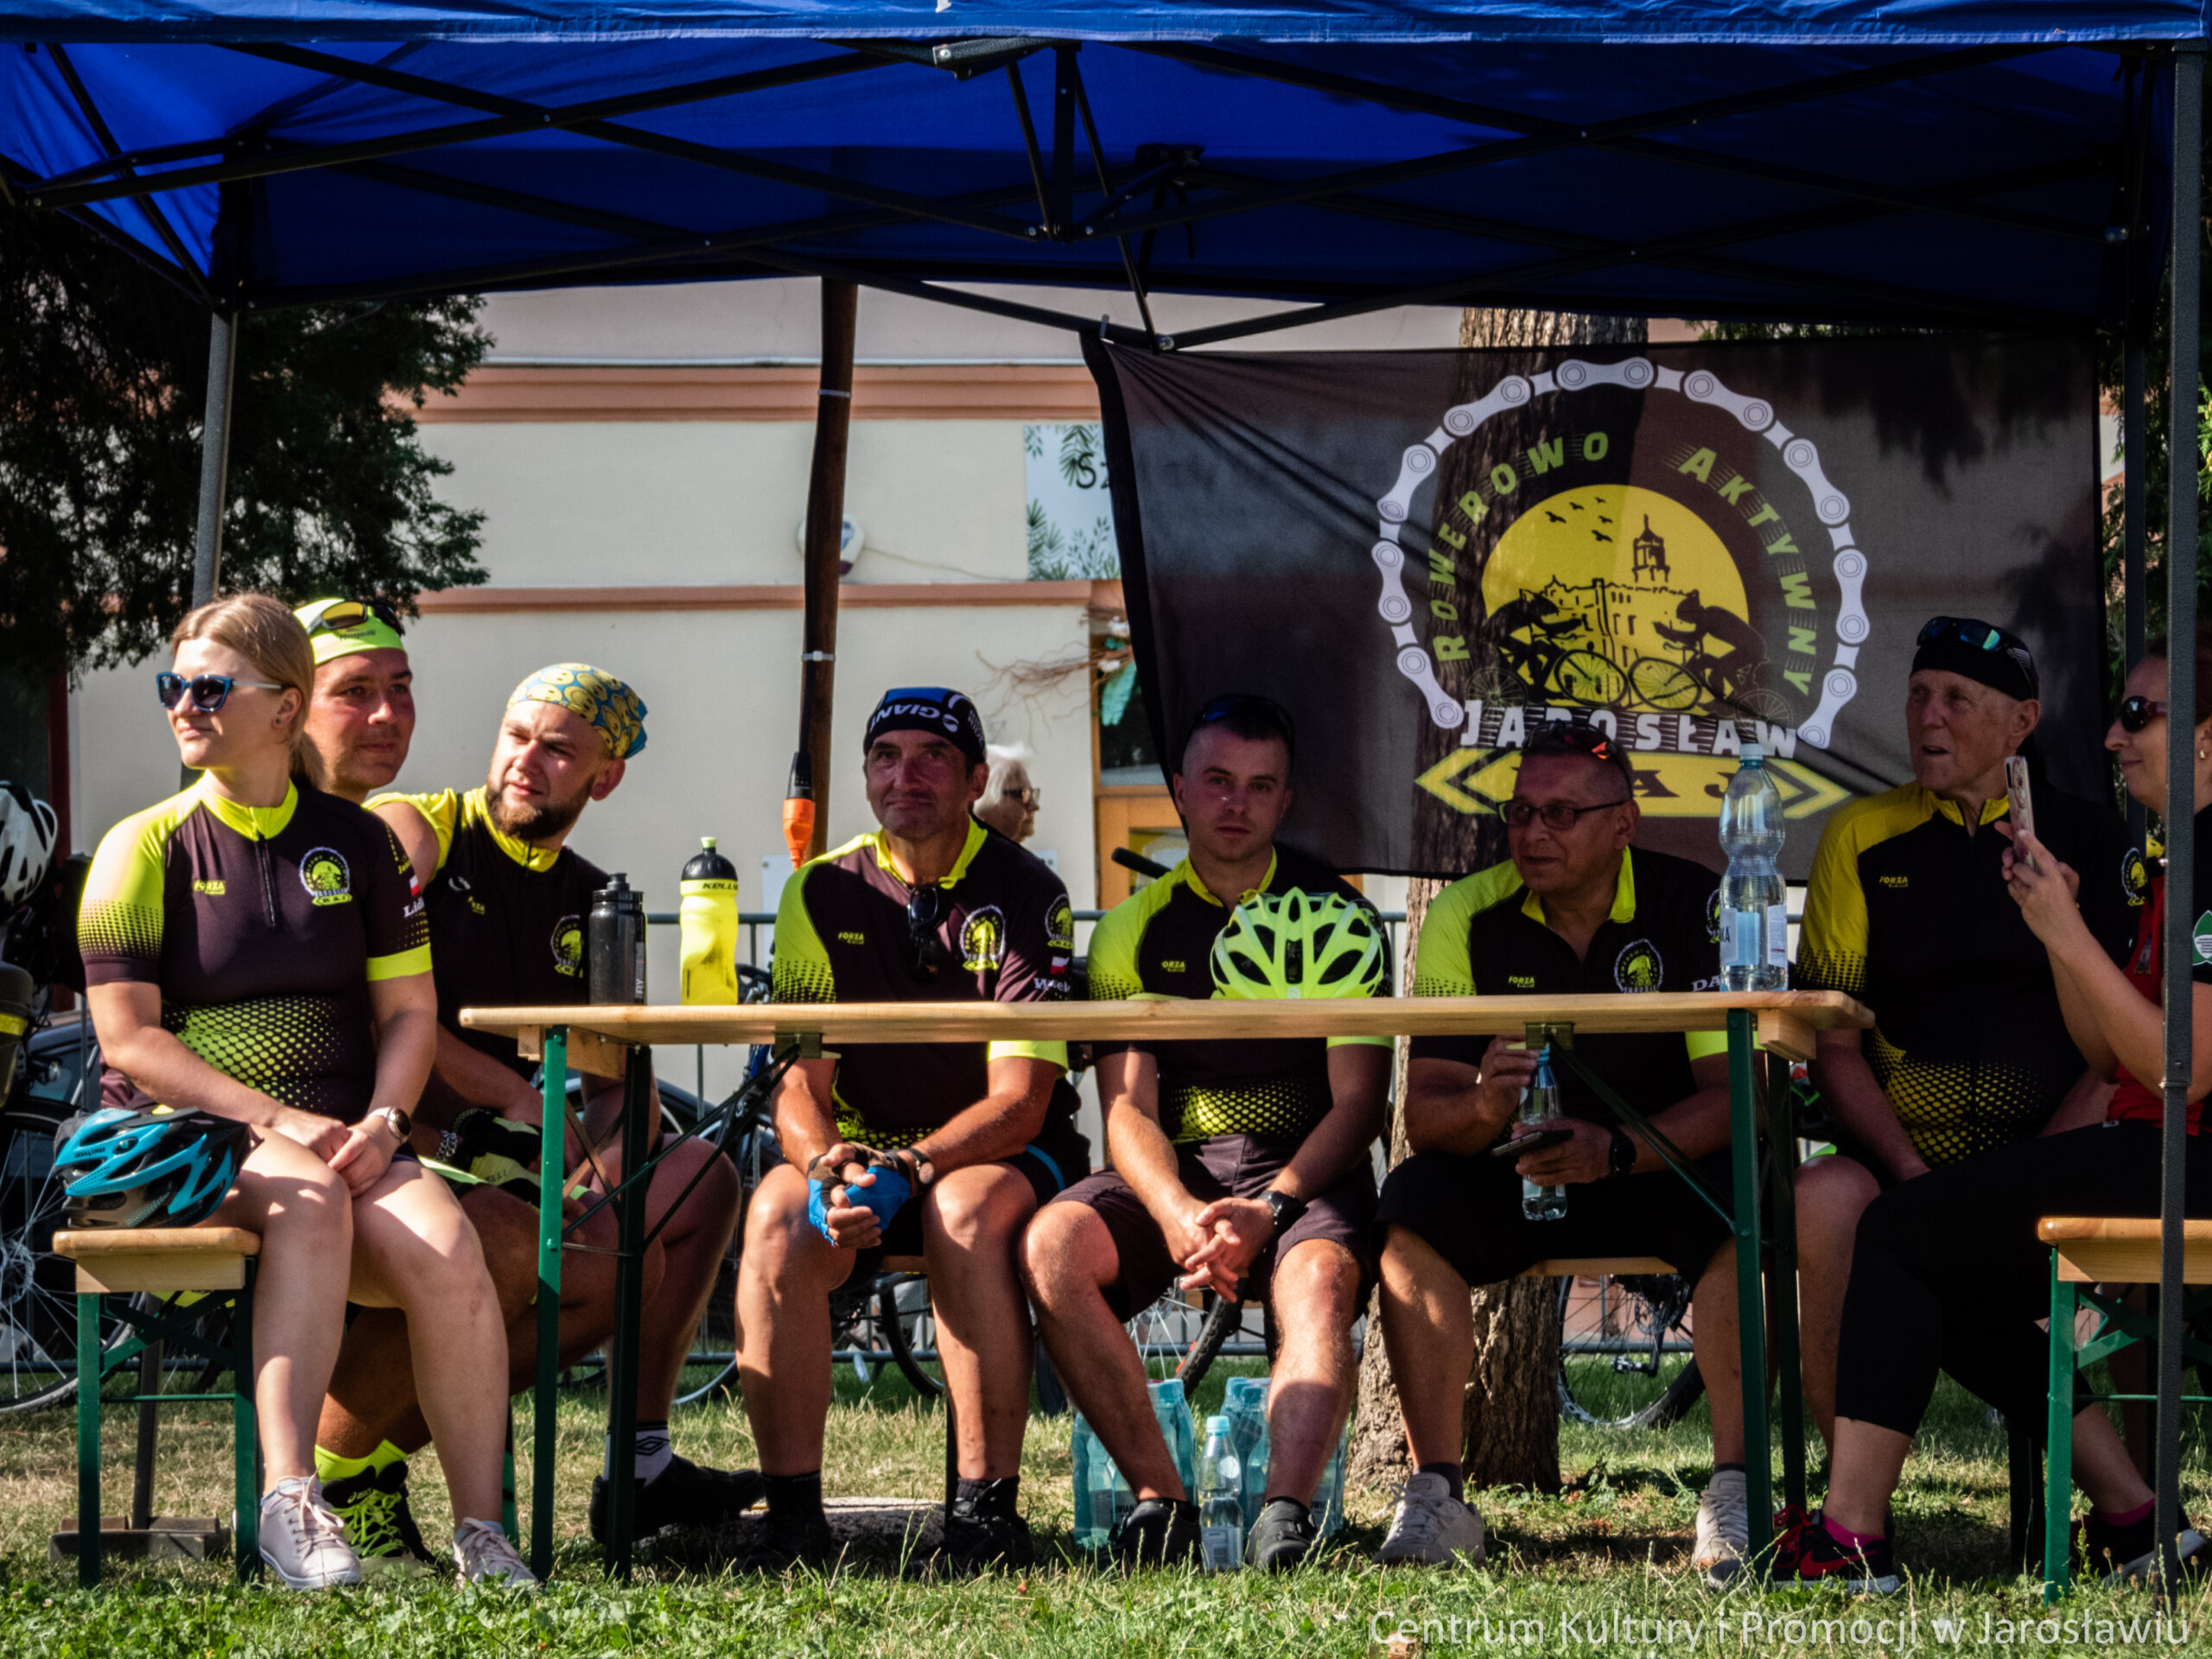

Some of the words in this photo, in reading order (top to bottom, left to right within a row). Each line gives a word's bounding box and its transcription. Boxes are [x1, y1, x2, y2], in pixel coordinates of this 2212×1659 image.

[1428, 431, 1609, 663] ROWEROWO
[1676, 446, 1817, 696] AKTYWNY
[837, 931, 864, 940] FORZA
[1508, 976, 1535, 984] FORZA
